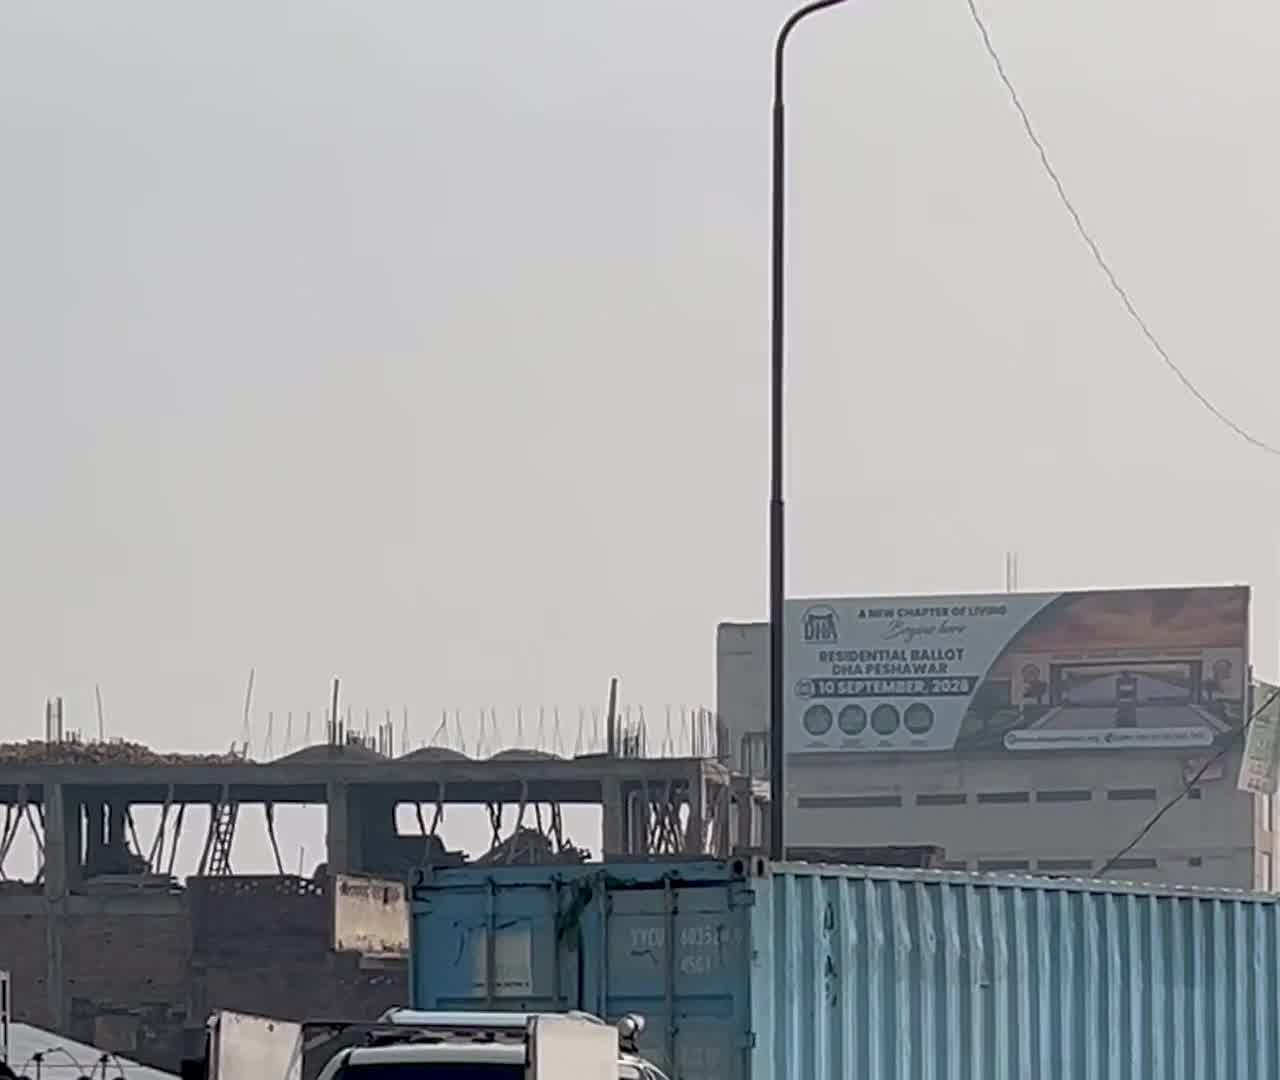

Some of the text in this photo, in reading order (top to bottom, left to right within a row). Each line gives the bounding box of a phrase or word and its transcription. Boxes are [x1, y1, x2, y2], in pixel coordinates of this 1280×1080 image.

[869, 607, 895, 618] NEW
[897, 606, 949, 618] CHAPTER
[951, 606, 968, 617] OF
[970, 605, 1008, 617] LIVING
[819, 648, 965, 663] RESIDENTIAL BALLOT
[831, 662, 949, 676] DHA PESHAWAR
[819, 680, 834, 694] 10
